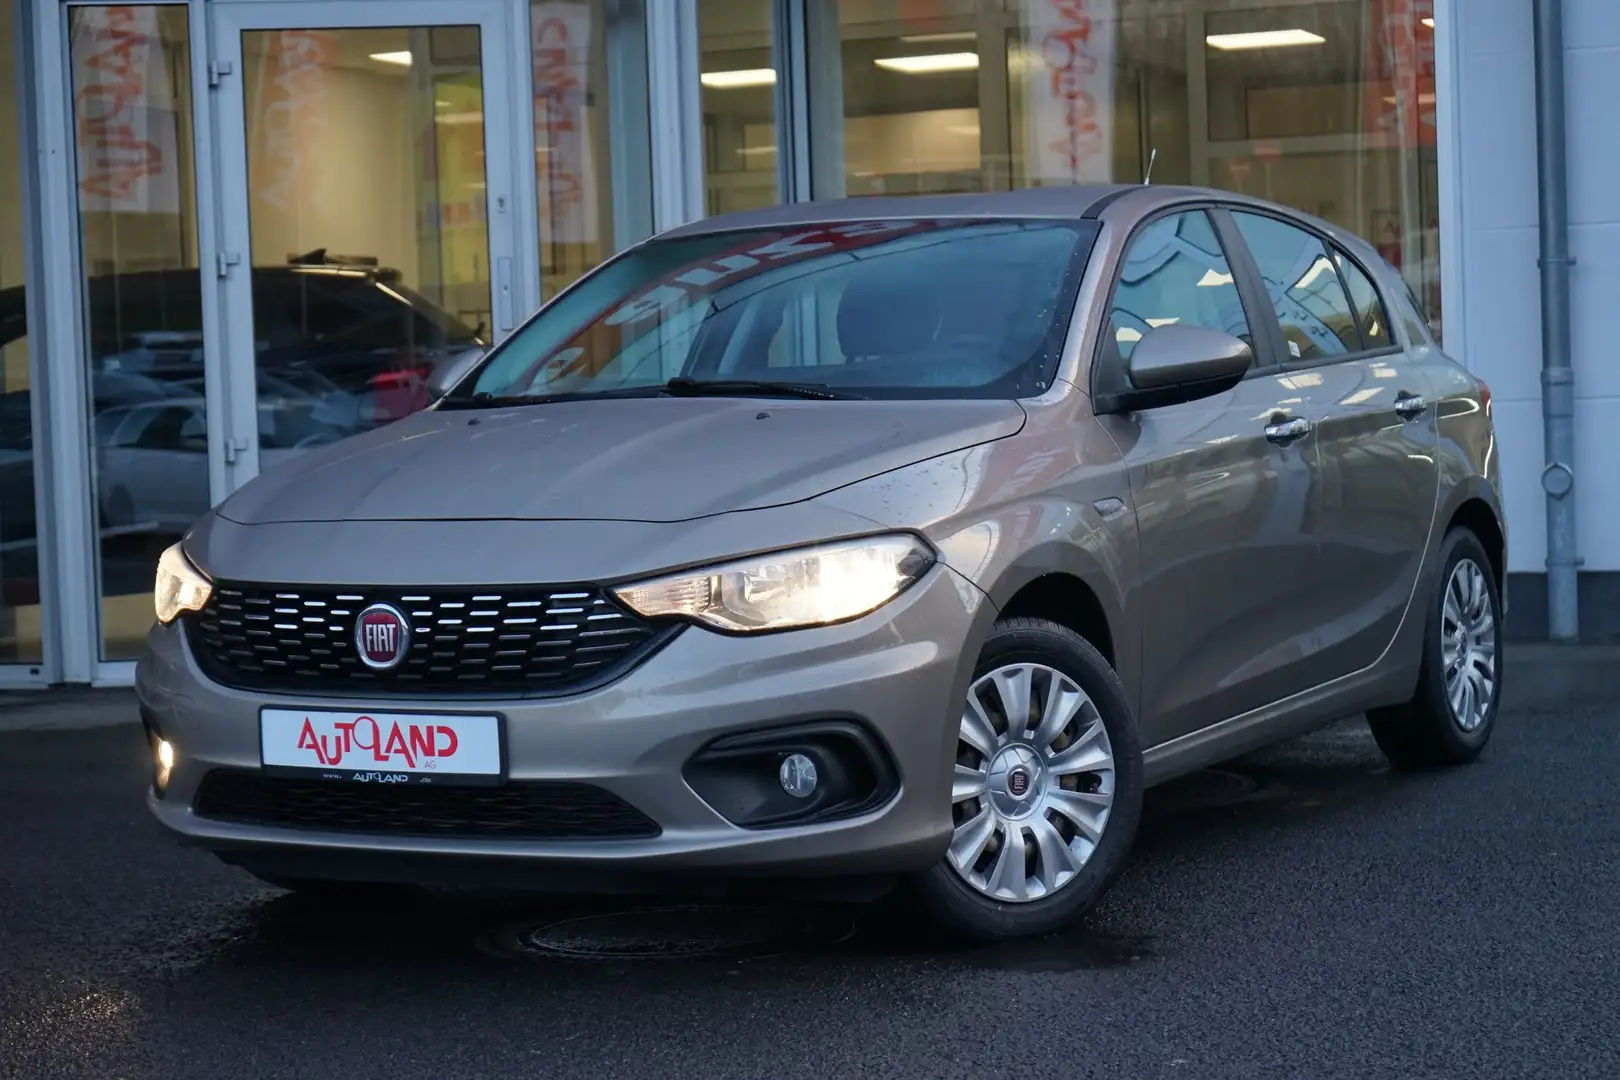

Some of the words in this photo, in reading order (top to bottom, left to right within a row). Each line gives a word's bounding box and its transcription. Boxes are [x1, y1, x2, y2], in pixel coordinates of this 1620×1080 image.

[365, 623, 396, 652] FIAT
[297, 716, 459, 768] AUTOLAND
[424, 760, 437, 769] AG
[352, 772, 409, 784] AUTOLAND
[419, 776, 432, 784] .de
